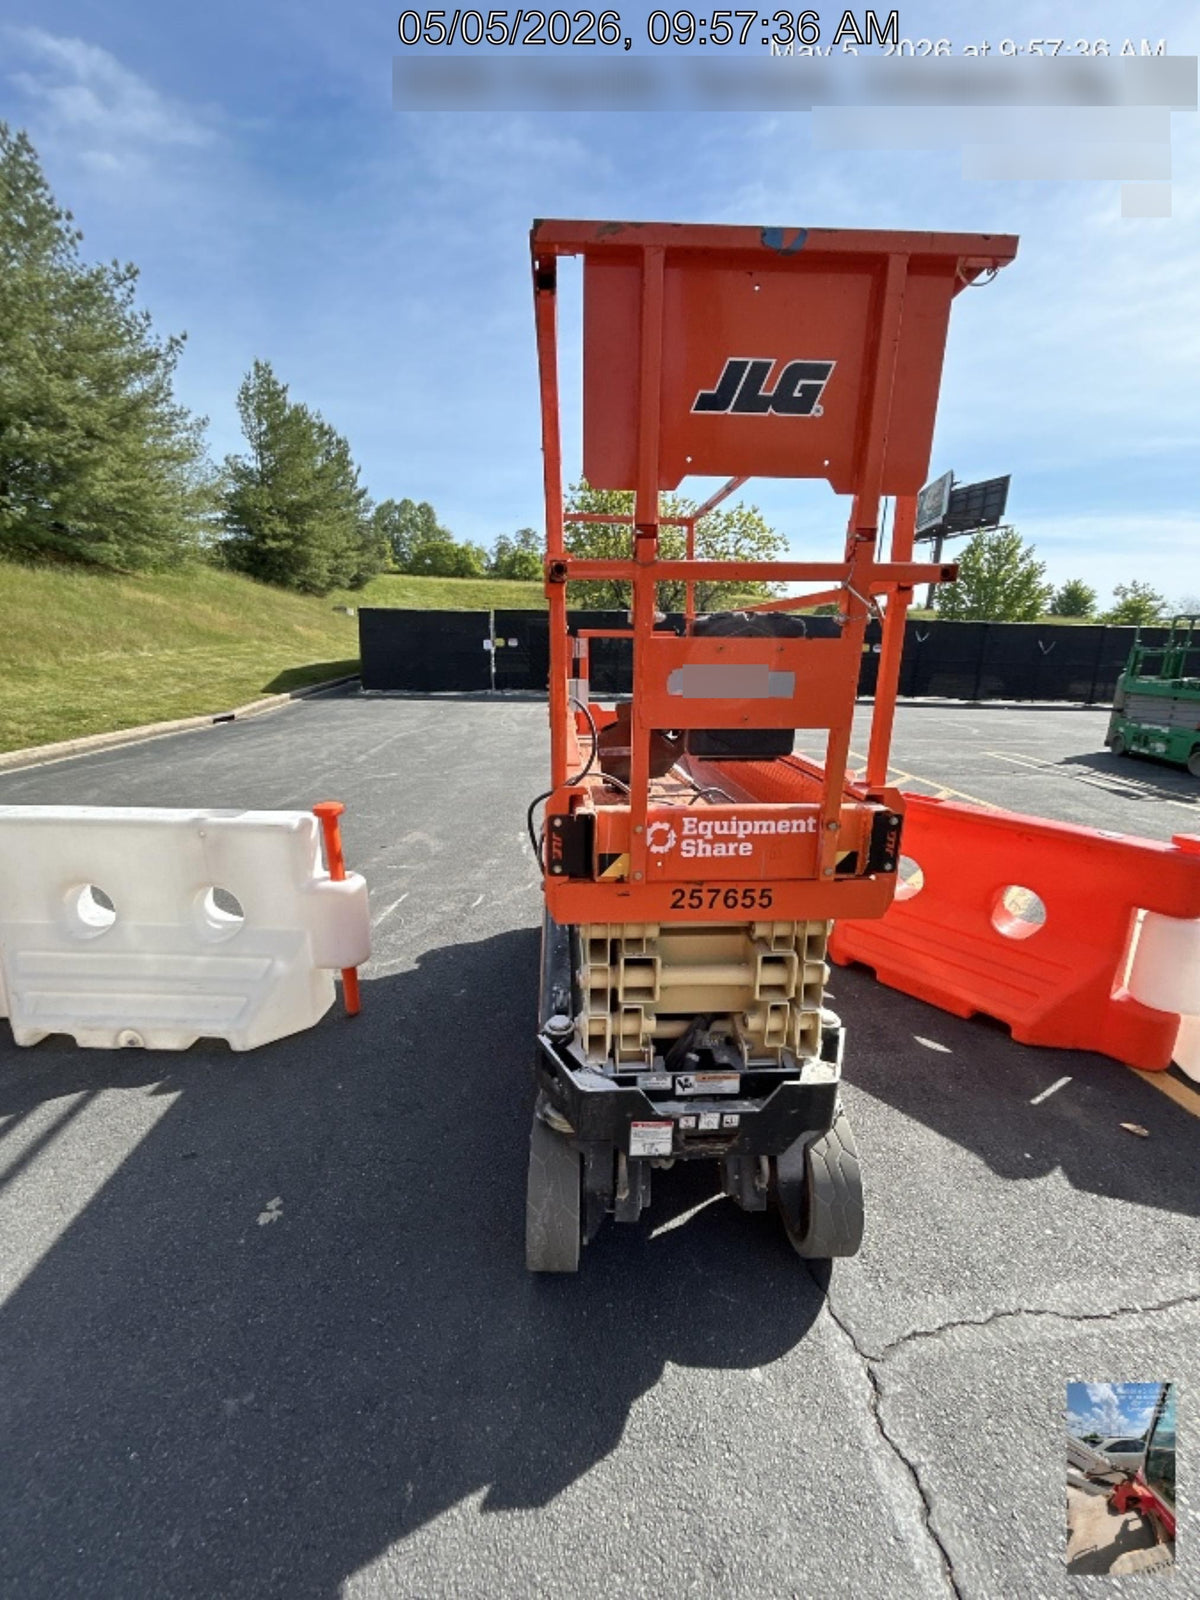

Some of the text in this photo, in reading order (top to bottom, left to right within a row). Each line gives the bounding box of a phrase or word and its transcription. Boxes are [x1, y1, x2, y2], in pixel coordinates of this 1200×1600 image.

[690, 357, 837, 417] JLG
[682, 816, 817, 839] Equipment
[681, 839, 753, 858] Share
[670, 888, 773, 910] 257655
